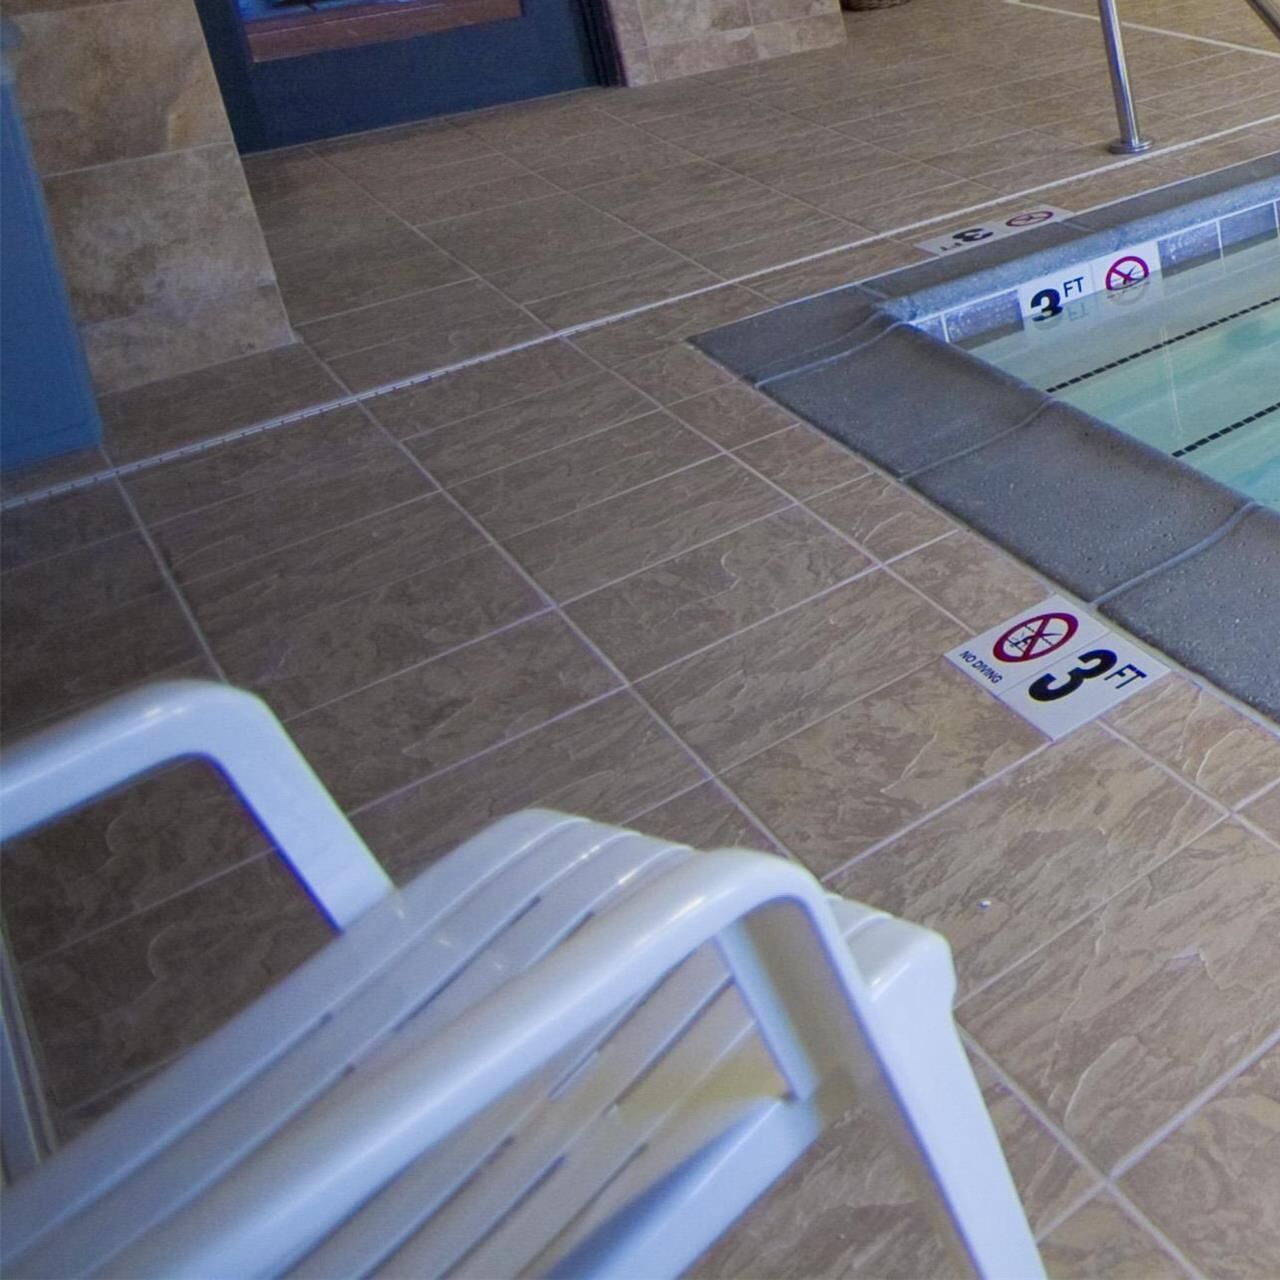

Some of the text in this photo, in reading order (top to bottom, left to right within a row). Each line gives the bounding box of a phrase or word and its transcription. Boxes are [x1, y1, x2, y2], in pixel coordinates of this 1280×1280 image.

[952, 228, 994, 242] 3
[1030, 276, 1085, 322] 3 FT
[958, 650, 1003, 684] NO DIVING
[1028, 649, 1148, 702] 3 FT
